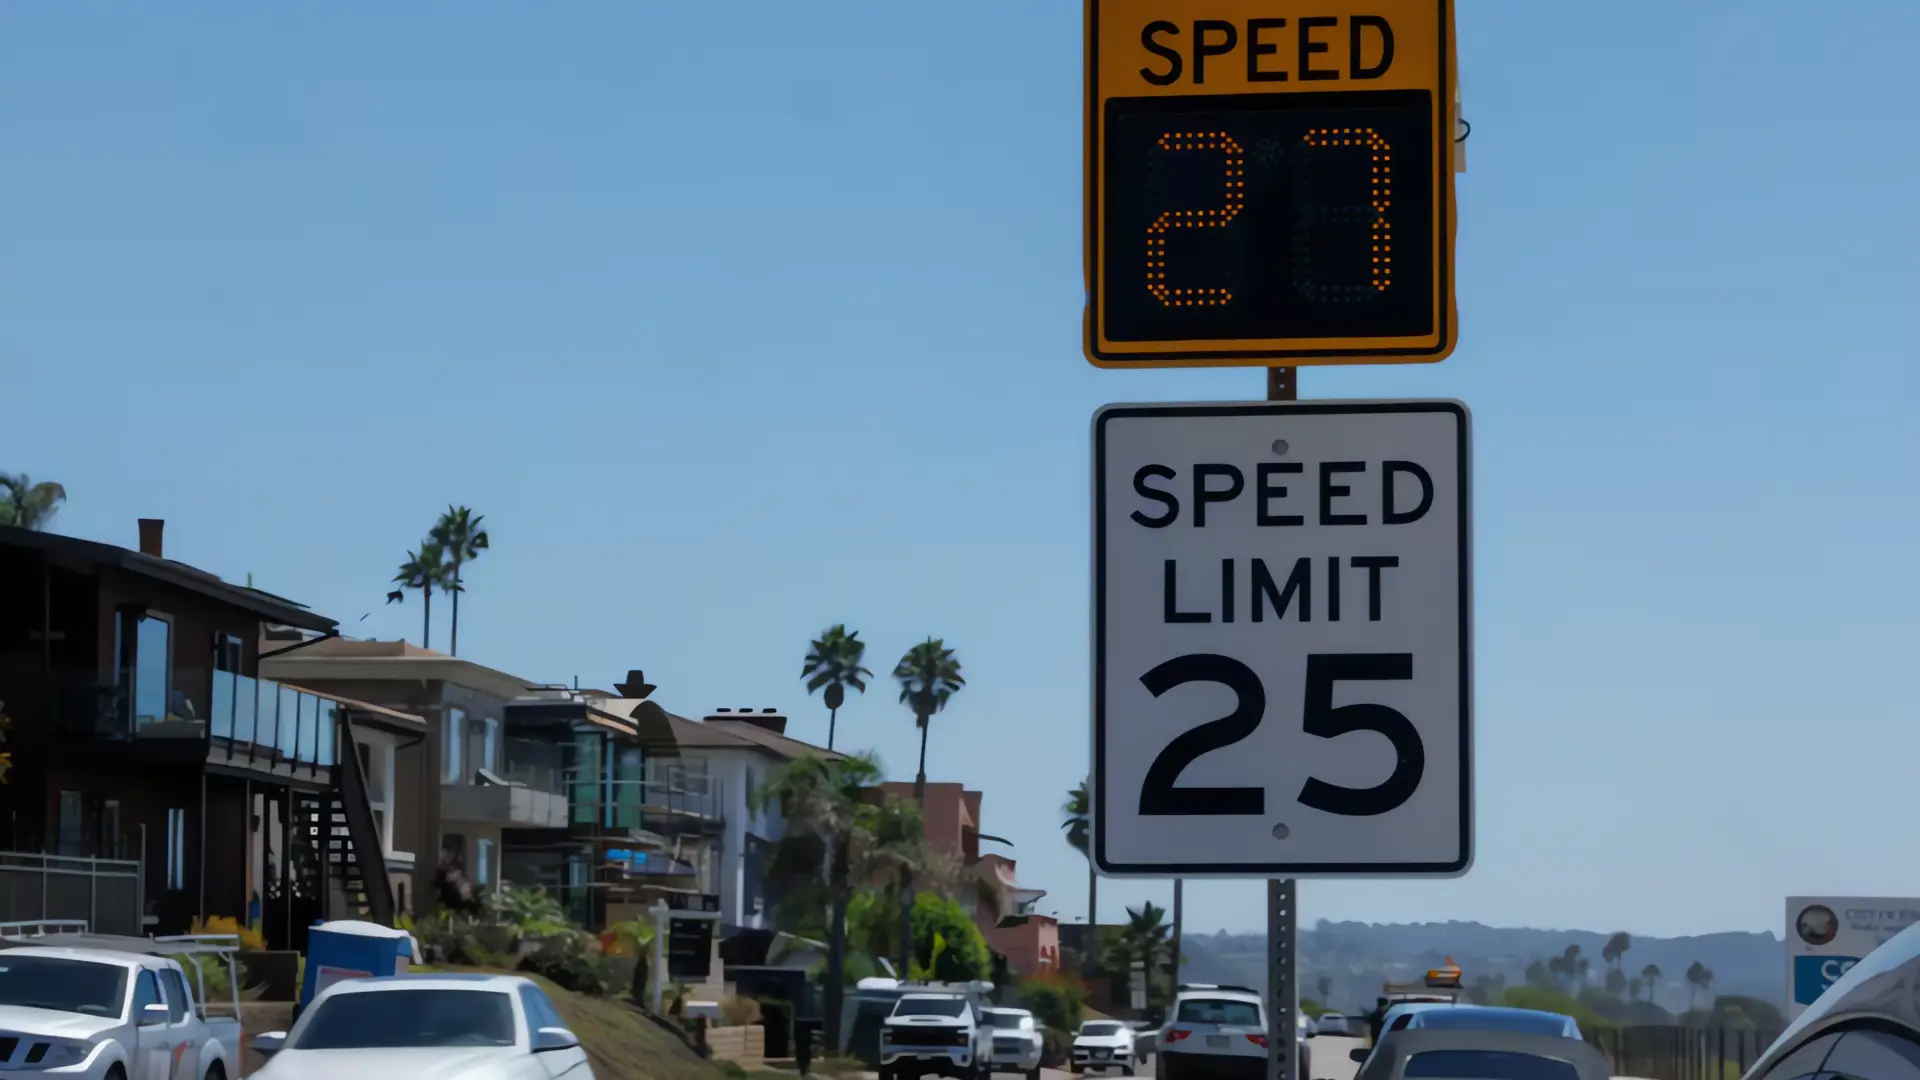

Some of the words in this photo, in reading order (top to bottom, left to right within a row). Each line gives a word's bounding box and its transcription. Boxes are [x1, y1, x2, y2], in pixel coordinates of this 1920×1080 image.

[1140, 16, 1394, 85] SPEED
[1147, 128, 1391, 306] 27
[1130, 461, 1434, 529] SPEED
[1164, 556, 1399, 624] LIMIT
[1138, 652, 1425, 816] 25
